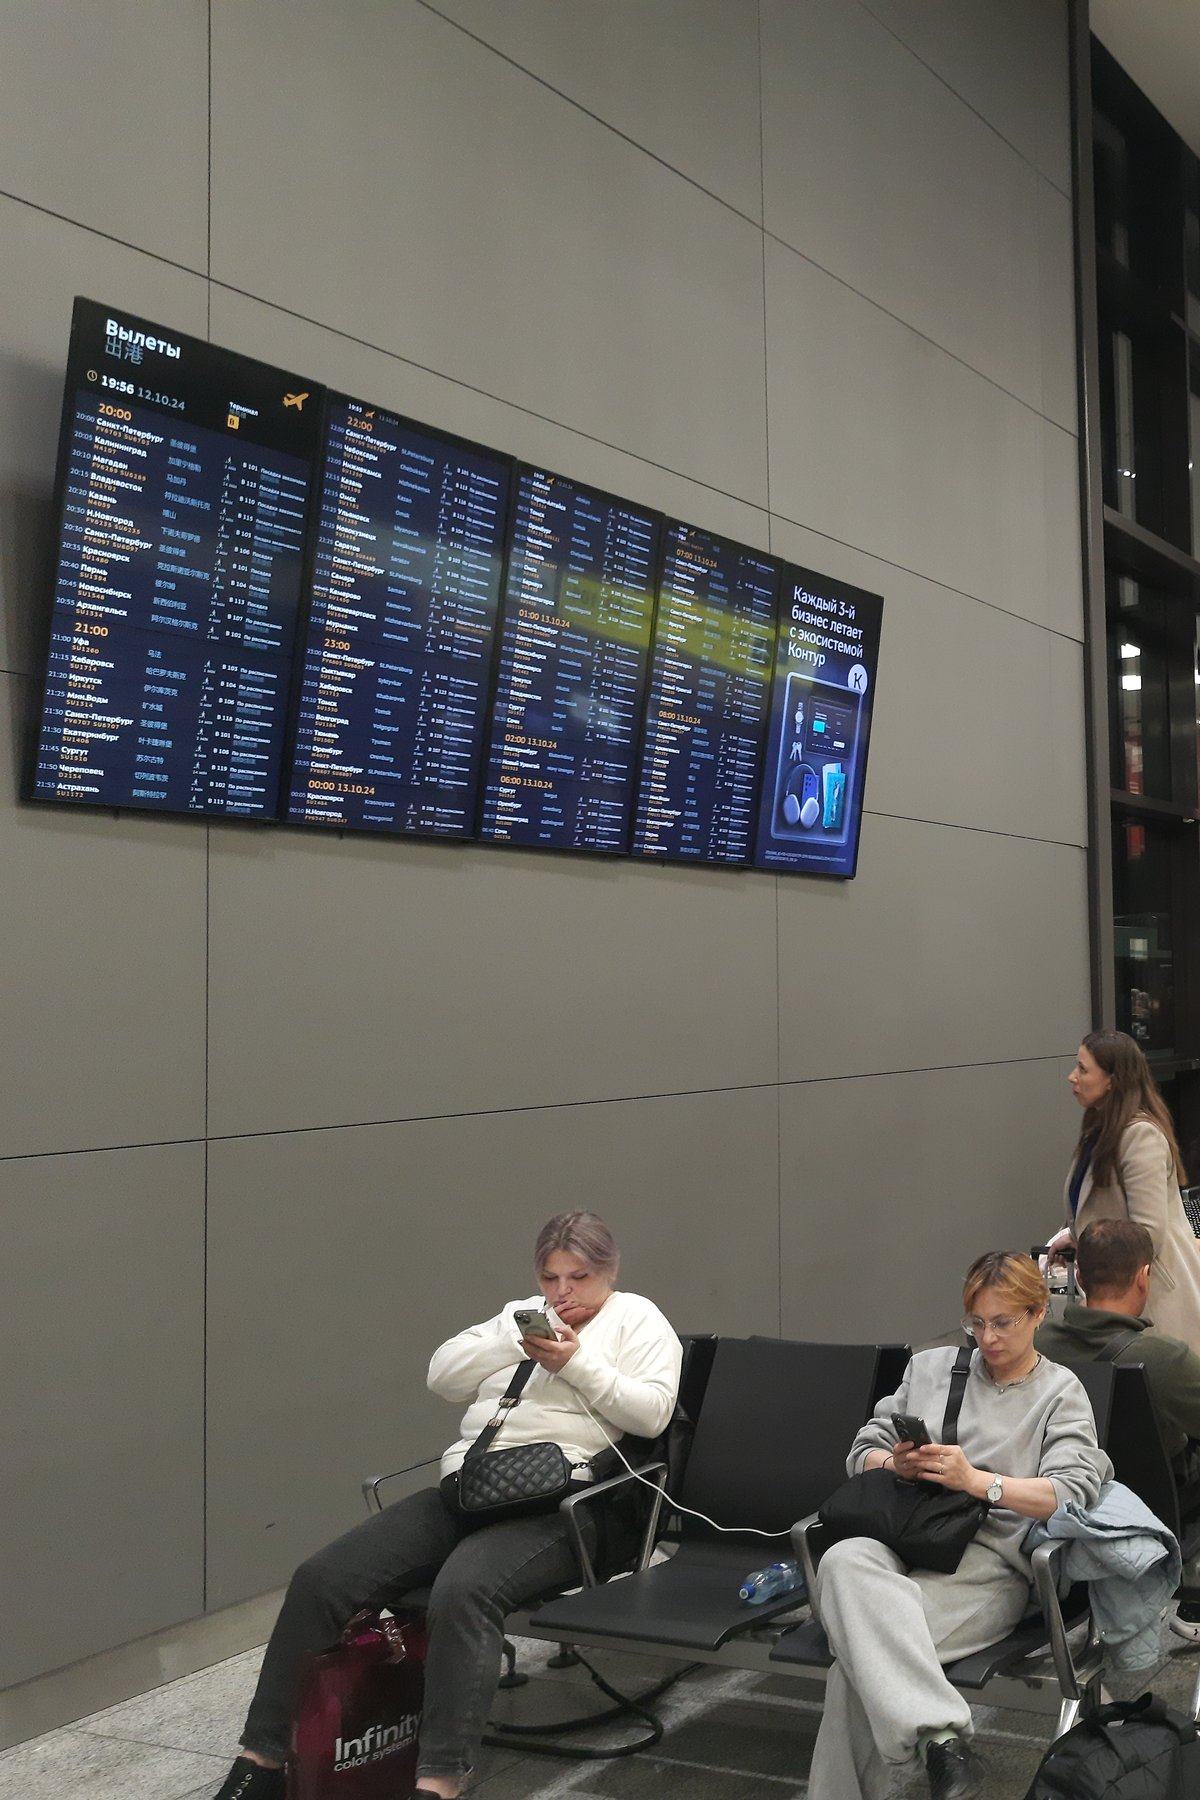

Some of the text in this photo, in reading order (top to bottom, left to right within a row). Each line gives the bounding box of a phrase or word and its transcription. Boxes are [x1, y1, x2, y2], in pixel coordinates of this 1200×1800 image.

[104, 318, 181, 361] Вылеты
[100, 374, 185, 412] 19:56 12.10.24
[98, 402, 132, 422] 20:00
[75, 411, 163, 446] 20:00 Санкт-Петербург
[346, 415, 373, 433] 22:00
[73, 430, 147, 460] 20:05 Калининград
[71, 448, 128, 472] 20:10 Магадан
[69, 466, 142, 493] 20:15 Владивосток
[67, 485, 117, 505] 20:20 Казань
[65, 503, 134, 529] 20:30 Н.Новгород
[63, 522, 152, 552] 20:30 Санкт-Петербург
[61, 541, 130, 565] 20:35 Красноярск
[59, 559, 108, 578] 20:40 Пермь
[57, 577, 132, 602] 20:45 Новосибирск
[55, 596, 128, 617] 20:55 Архангельск
[793, 584, 856, 620] Каждый 3-й
[518, 608, 570, 629] 01:00 13.10.24
[791, 604, 863, 640] бизнес летает
[73, 621, 109, 638] 21:00
[51, 633, 90, 648] 21:00 Уфа
[323, 637, 350, 652] 23:00
[790, 627, 863, 659] с экосистемой
[49, 651, 114, 669] 21:15 Хабаровск
[788, 642, 826, 668] Контур
[47, 669, 102, 687] 21:20 Иркутск
[45, 688, 108, 706] 21:25 Мин.Воды
[43, 706, 133, 728] 21:30 Санкт-Петербург
[41, 725, 119, 743] 21:30 Екатеринбург
[504, 733, 557, 750] 02:00 13.10.24
[39, 743, 88, 758] 21:45 Сургут
[37, 762, 104, 778] 21:50 Череповец
[35, 780, 100, 794] 21:55 Астрахань
[308, 779, 375, 796] 00:00 13.10.24
[500, 774, 553, 790] 06:00 13.10.24
[335, 1710, 422, 1762] Infinity
[334, 1736, 412, 1772] color system
